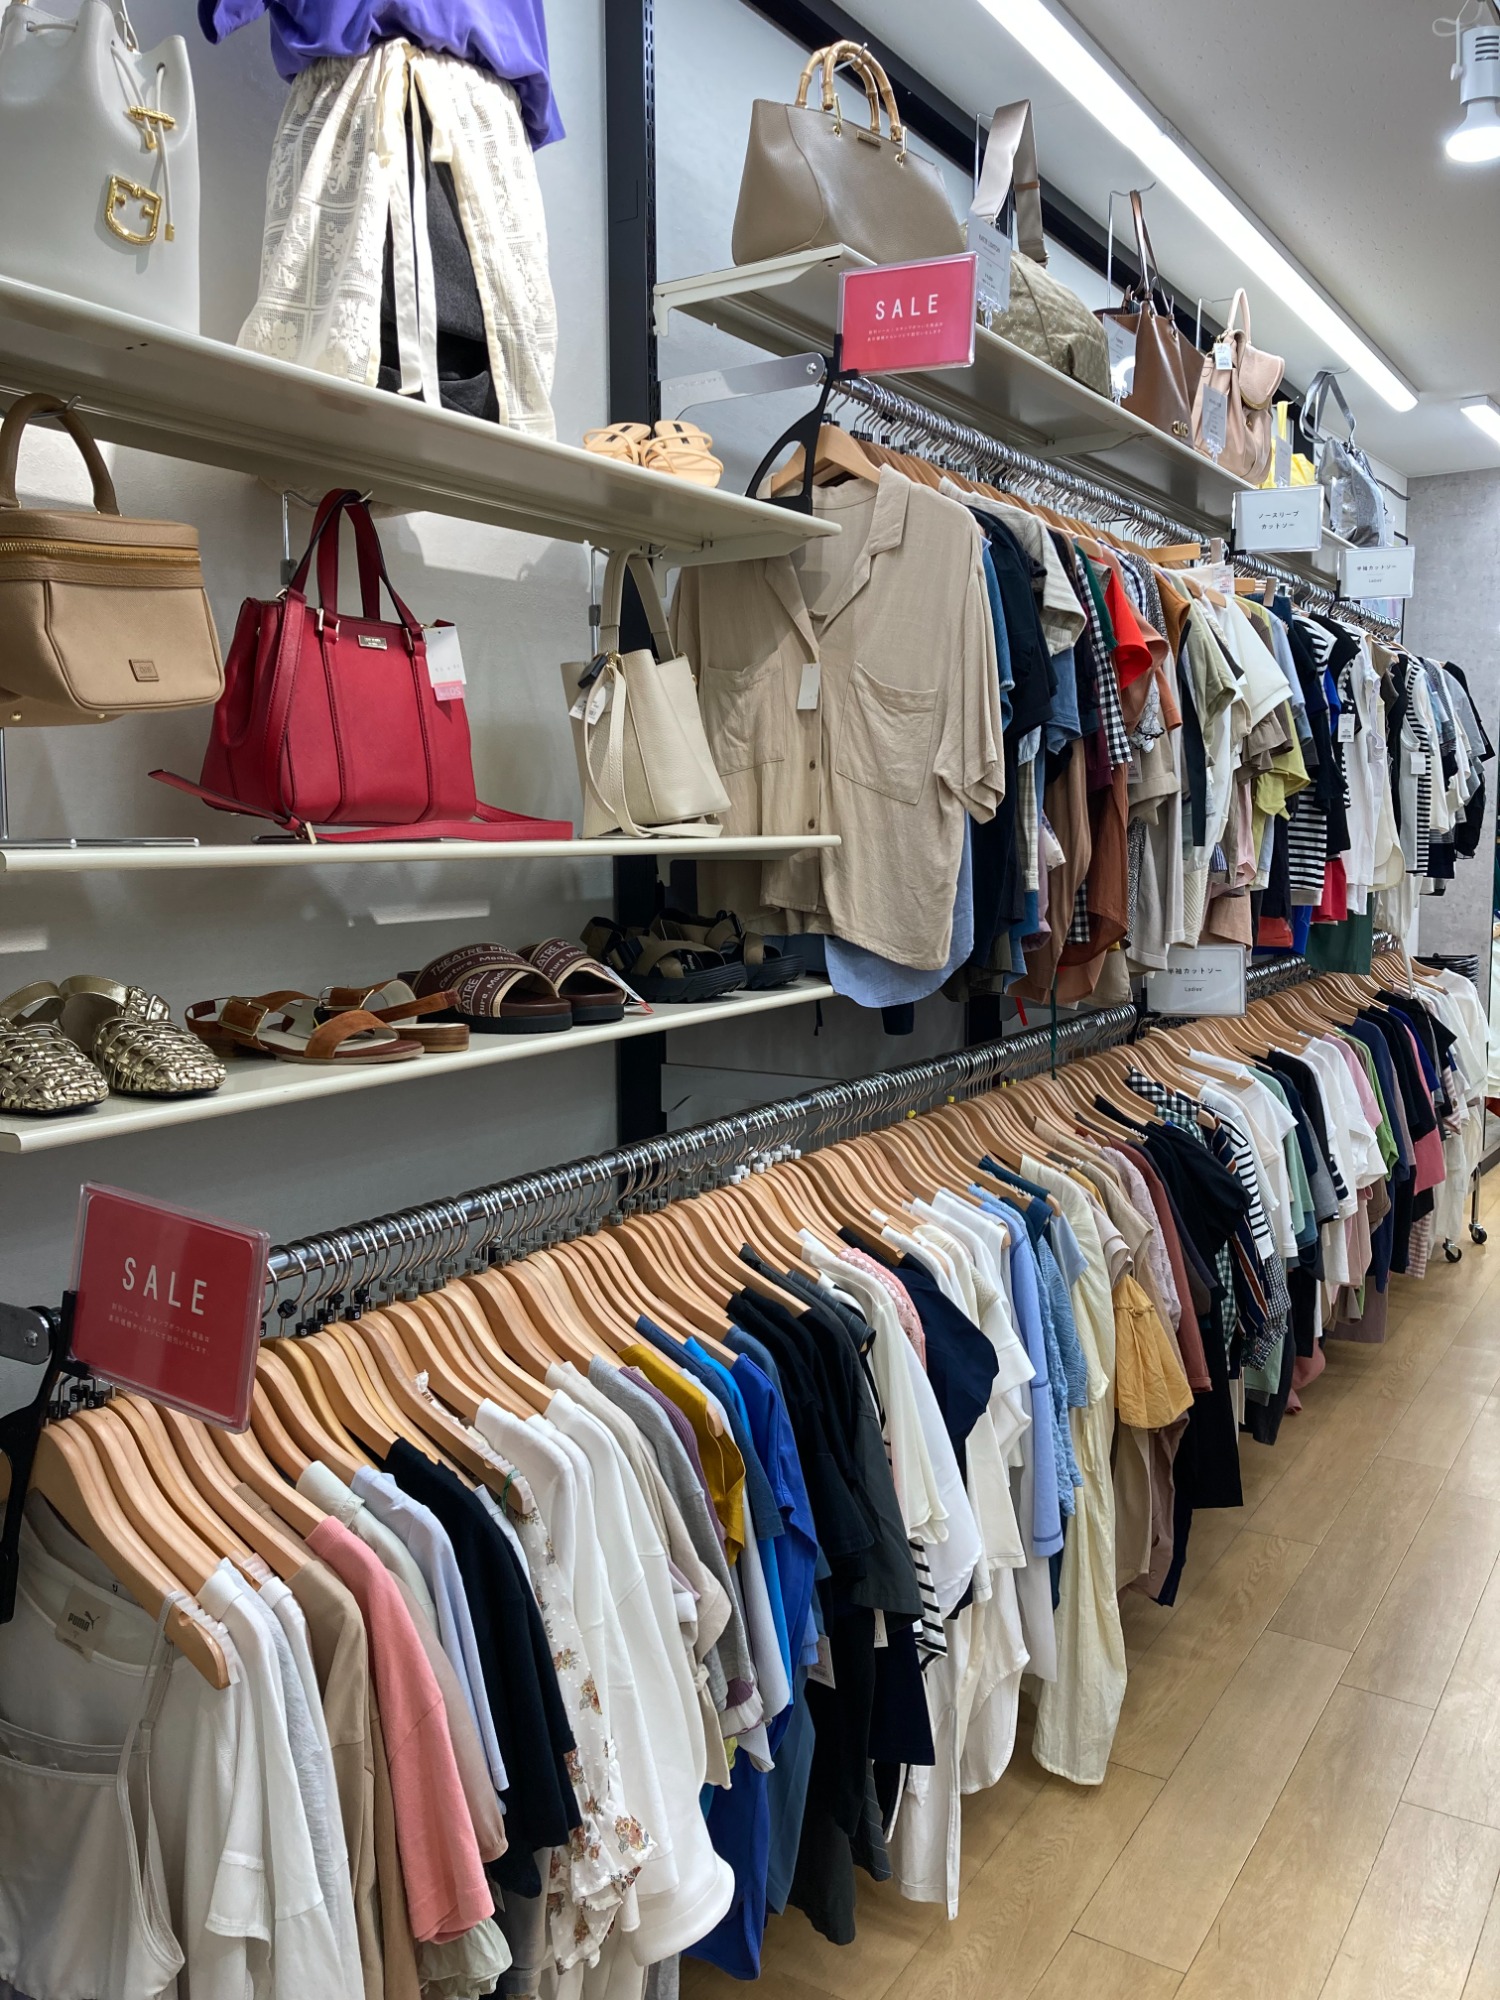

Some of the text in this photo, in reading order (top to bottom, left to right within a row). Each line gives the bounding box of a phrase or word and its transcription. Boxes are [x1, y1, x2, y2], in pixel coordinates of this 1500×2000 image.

[875, 293, 939, 321] SALE
[430, 946, 485, 977] THEATRE
[122, 1256, 208, 1316] SALE
[67, 1612, 90, 1633] PUMA
